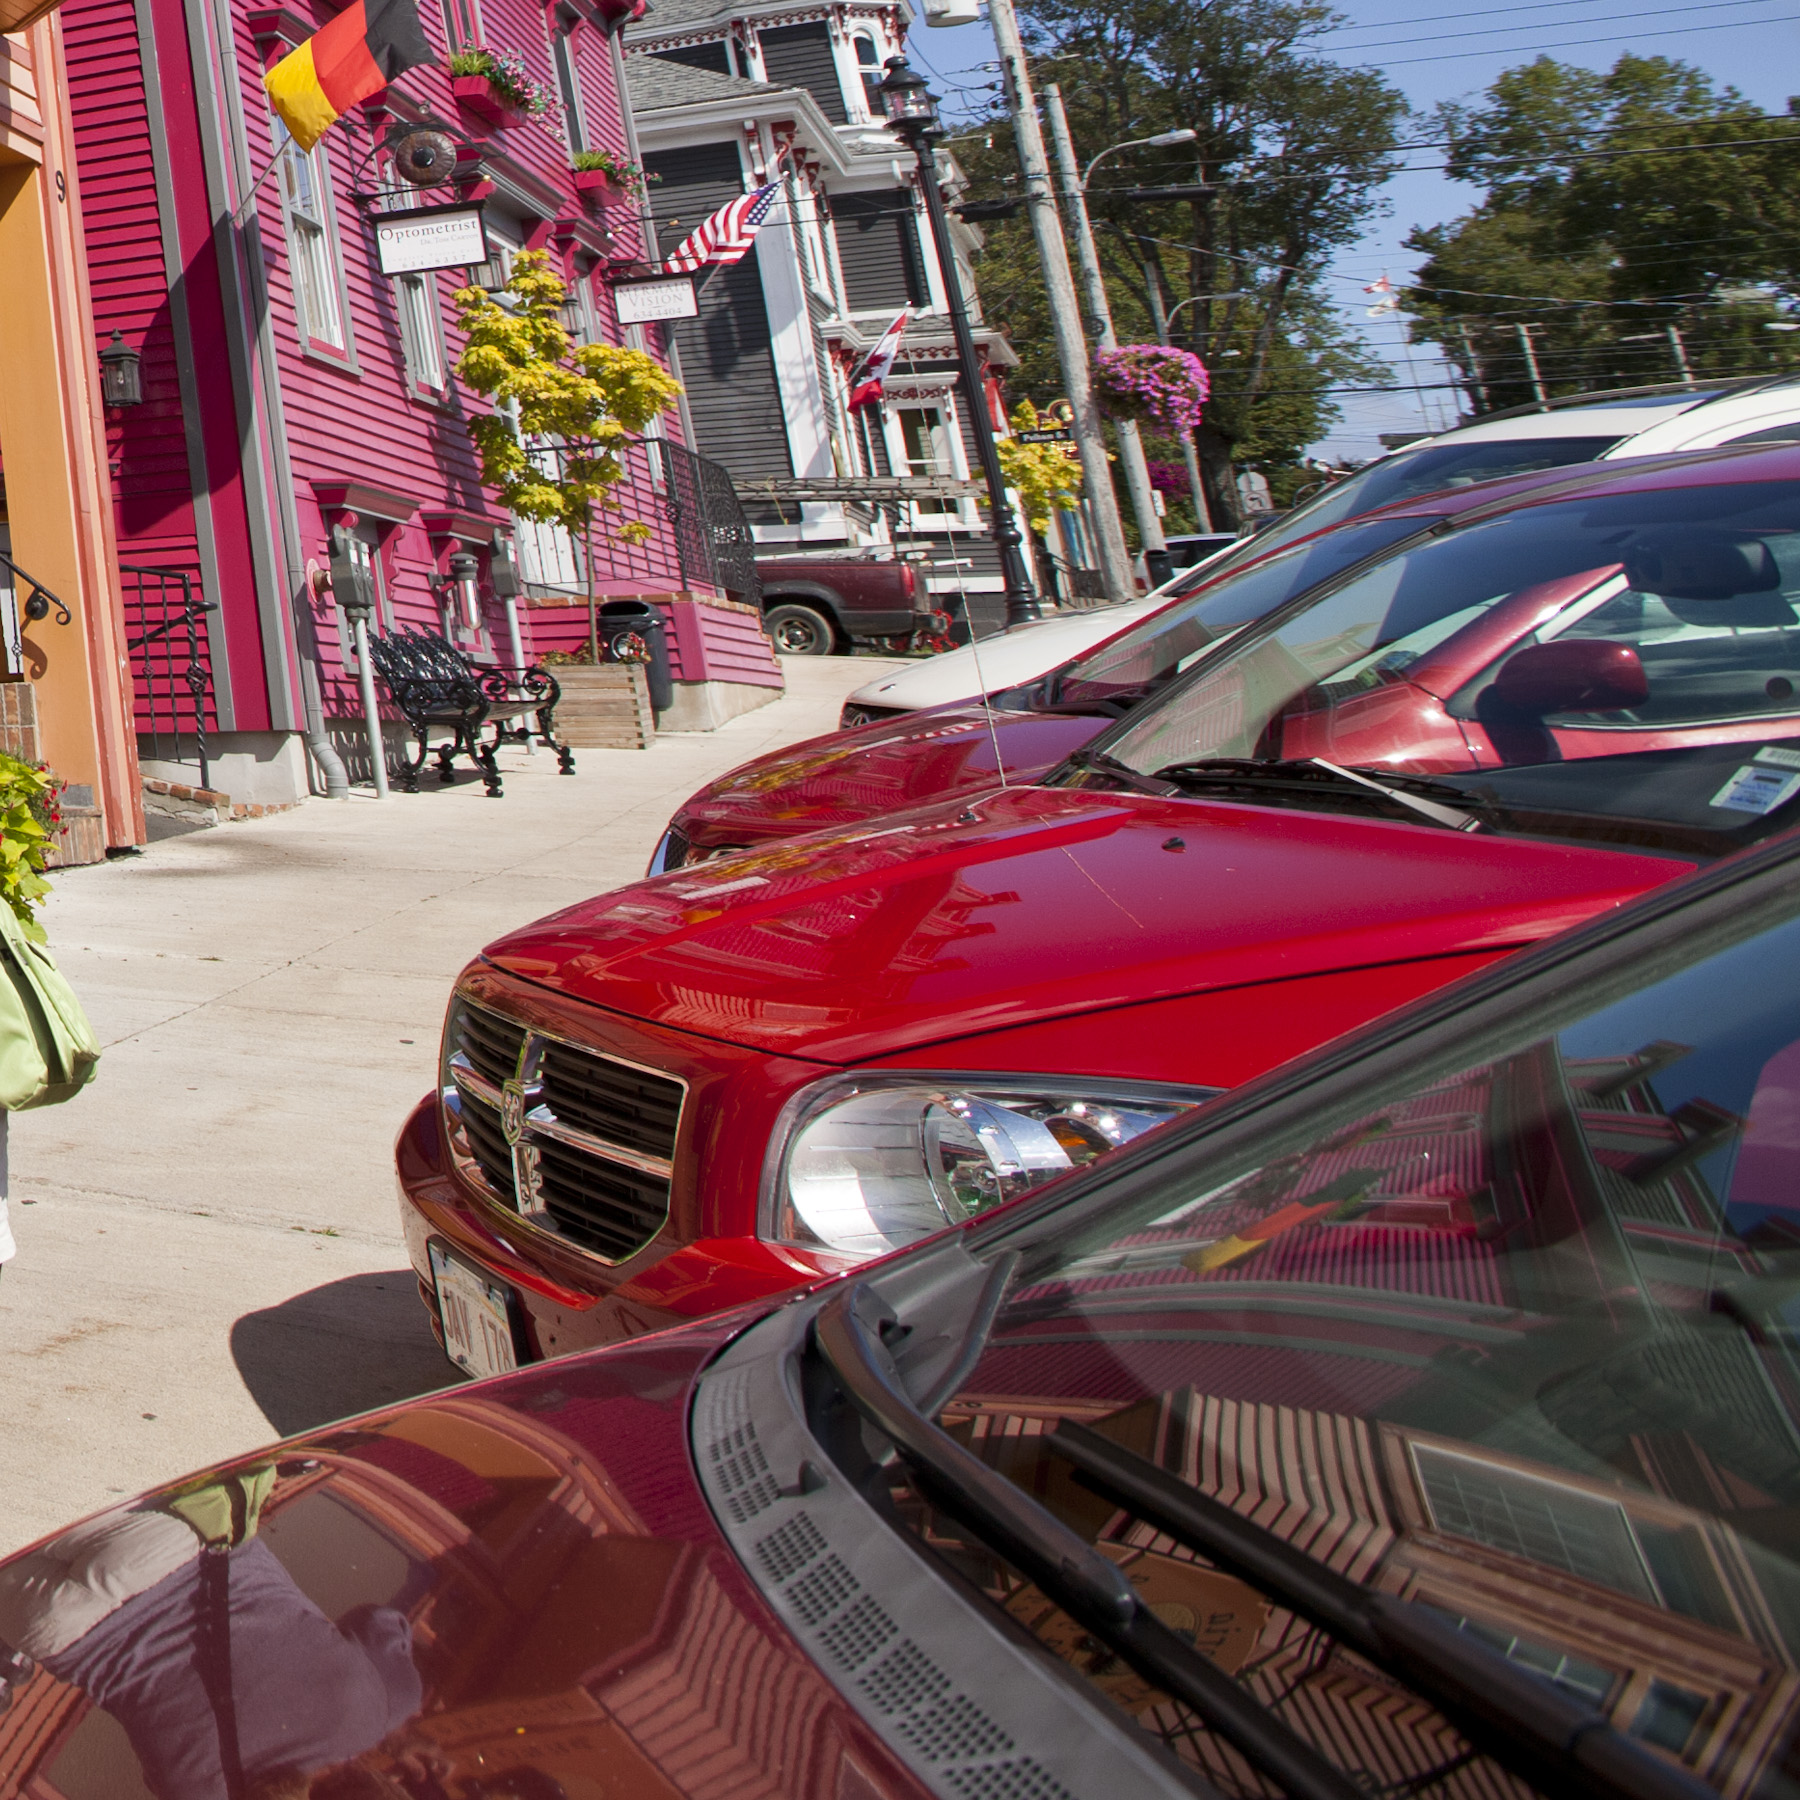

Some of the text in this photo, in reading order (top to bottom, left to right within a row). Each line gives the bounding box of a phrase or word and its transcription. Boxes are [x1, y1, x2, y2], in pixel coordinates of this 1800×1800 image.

[55, 170, 66, 204] 9
[380, 220, 476, 243] Optometrist
[619, 281, 691, 298] MERMAID
[629, 293, 683, 307] VISION
[442, 1286, 514, 1373] JAV 178
